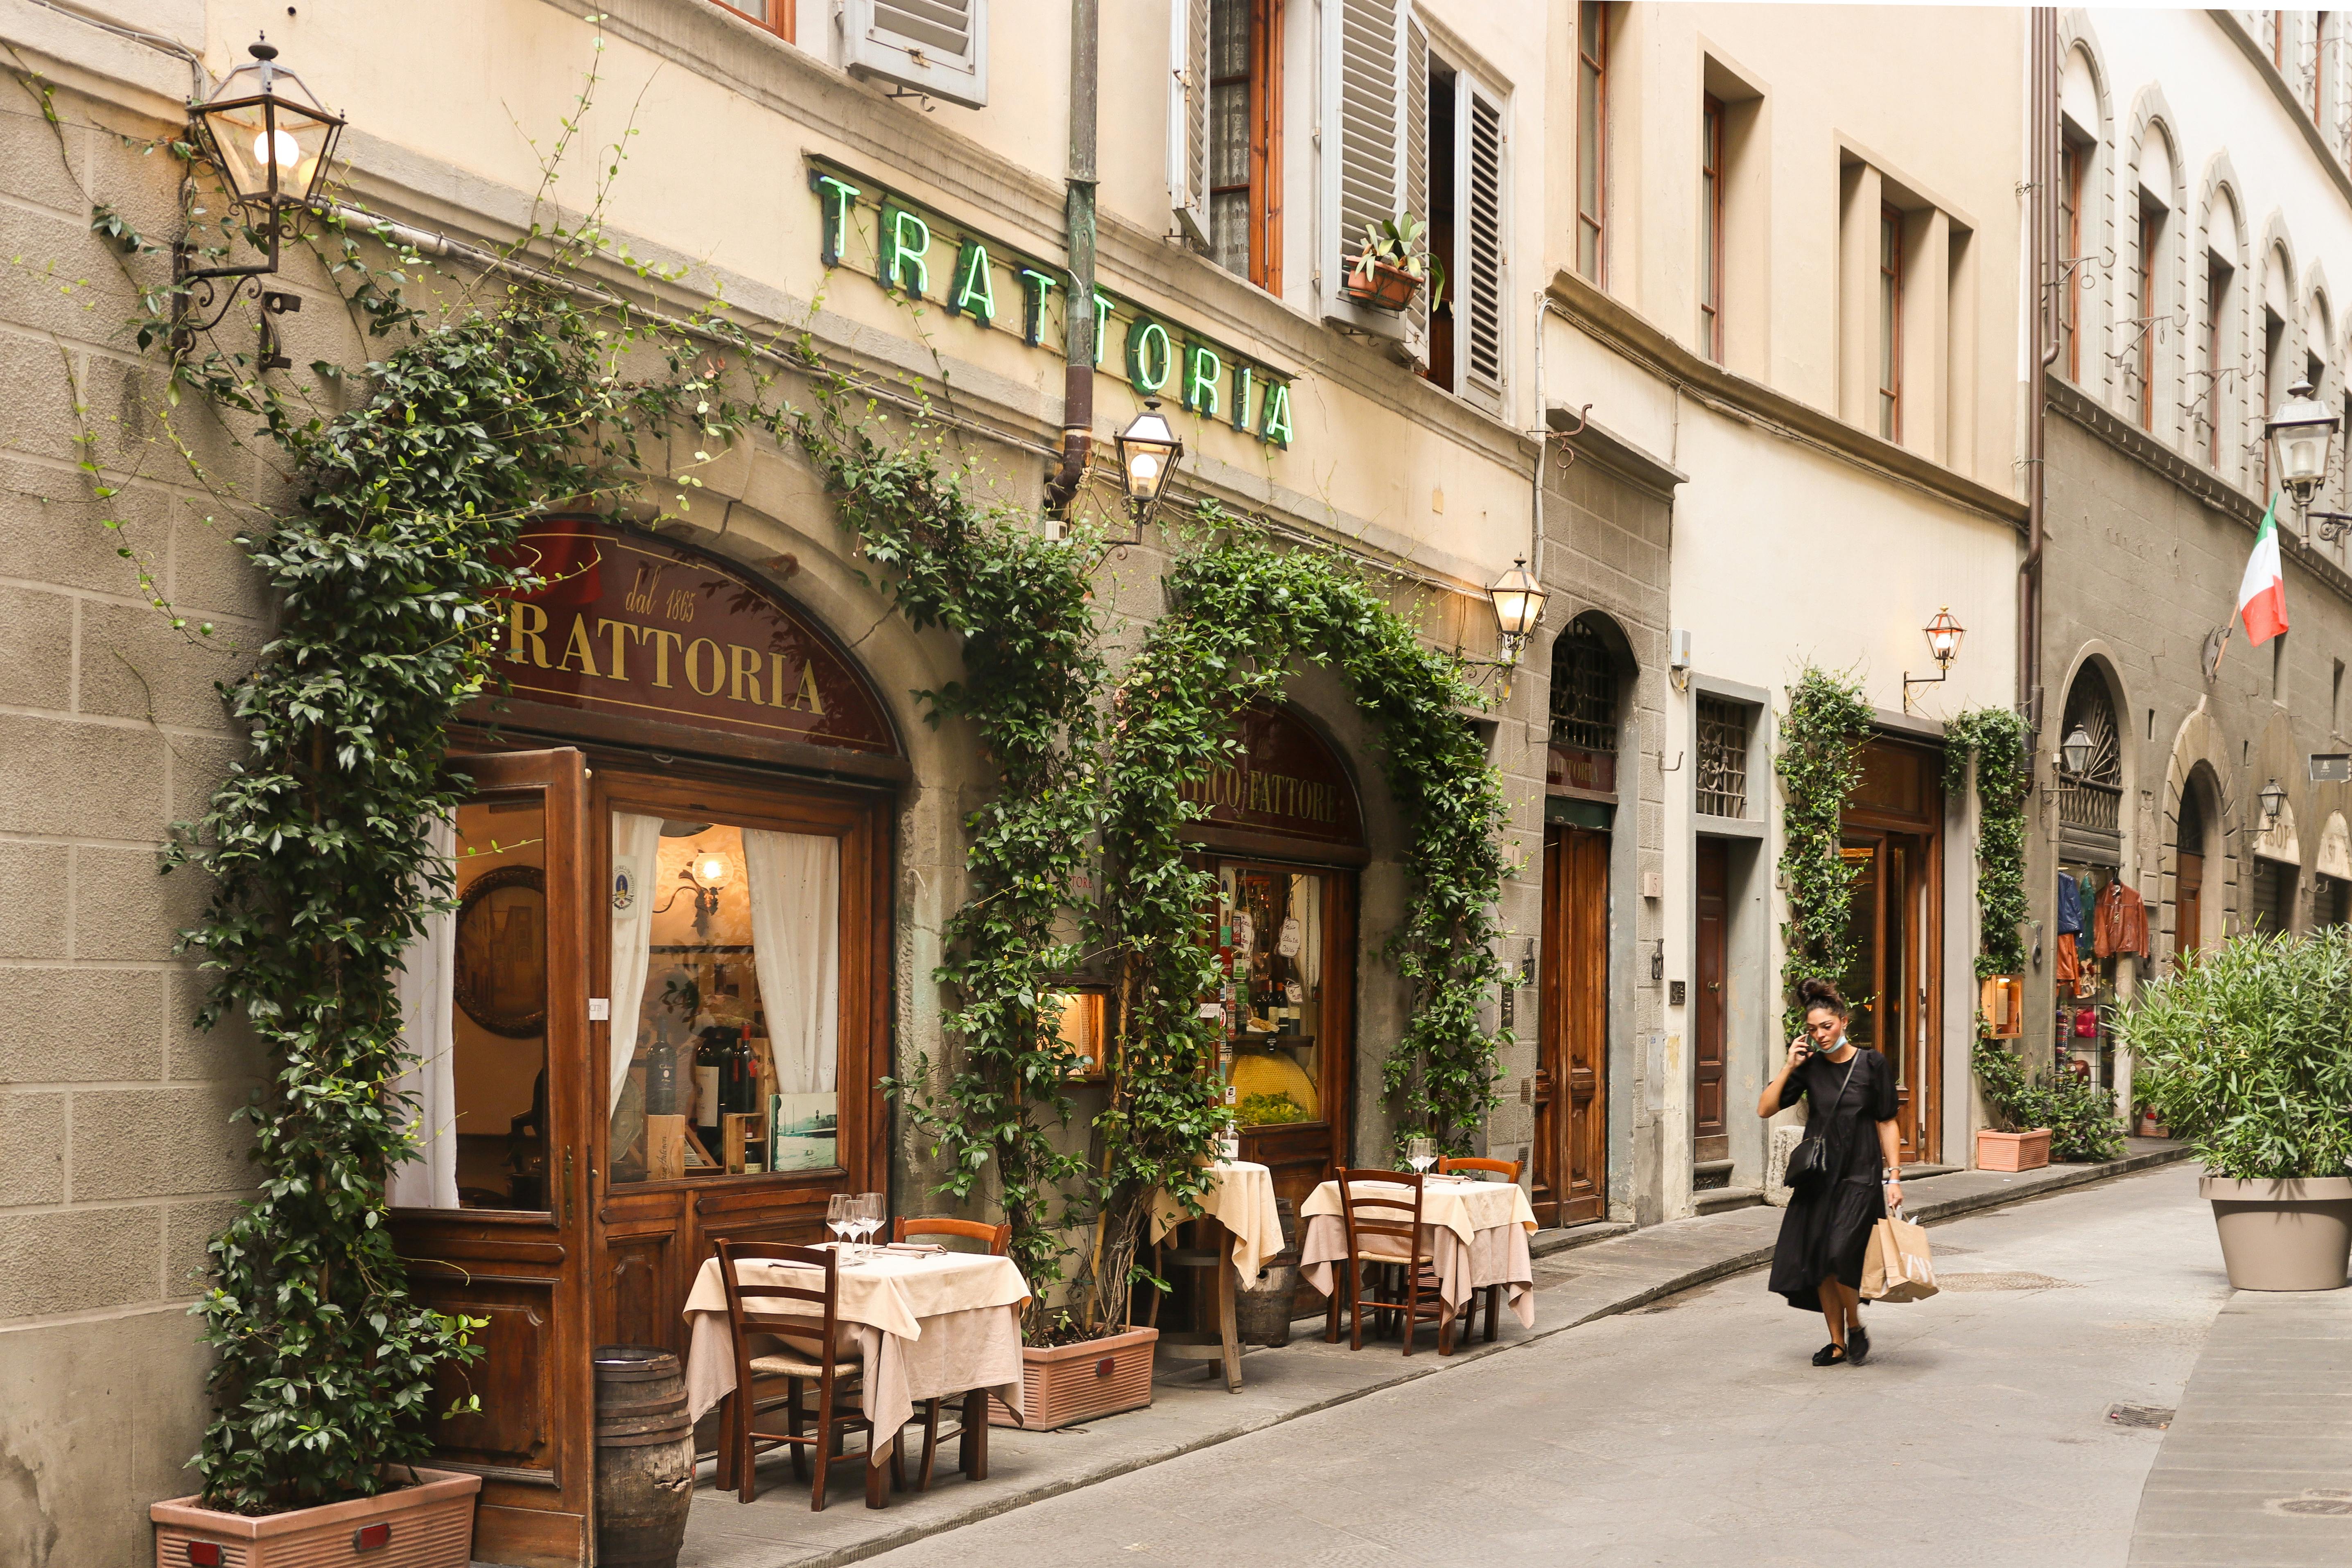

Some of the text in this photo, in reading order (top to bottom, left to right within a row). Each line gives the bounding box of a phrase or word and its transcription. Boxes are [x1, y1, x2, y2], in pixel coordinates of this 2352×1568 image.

[809, 168, 1294, 452] TRATTORIA
[626, 565, 696, 622] dal 1865
[1249, 770, 1336, 823] FATTORE
